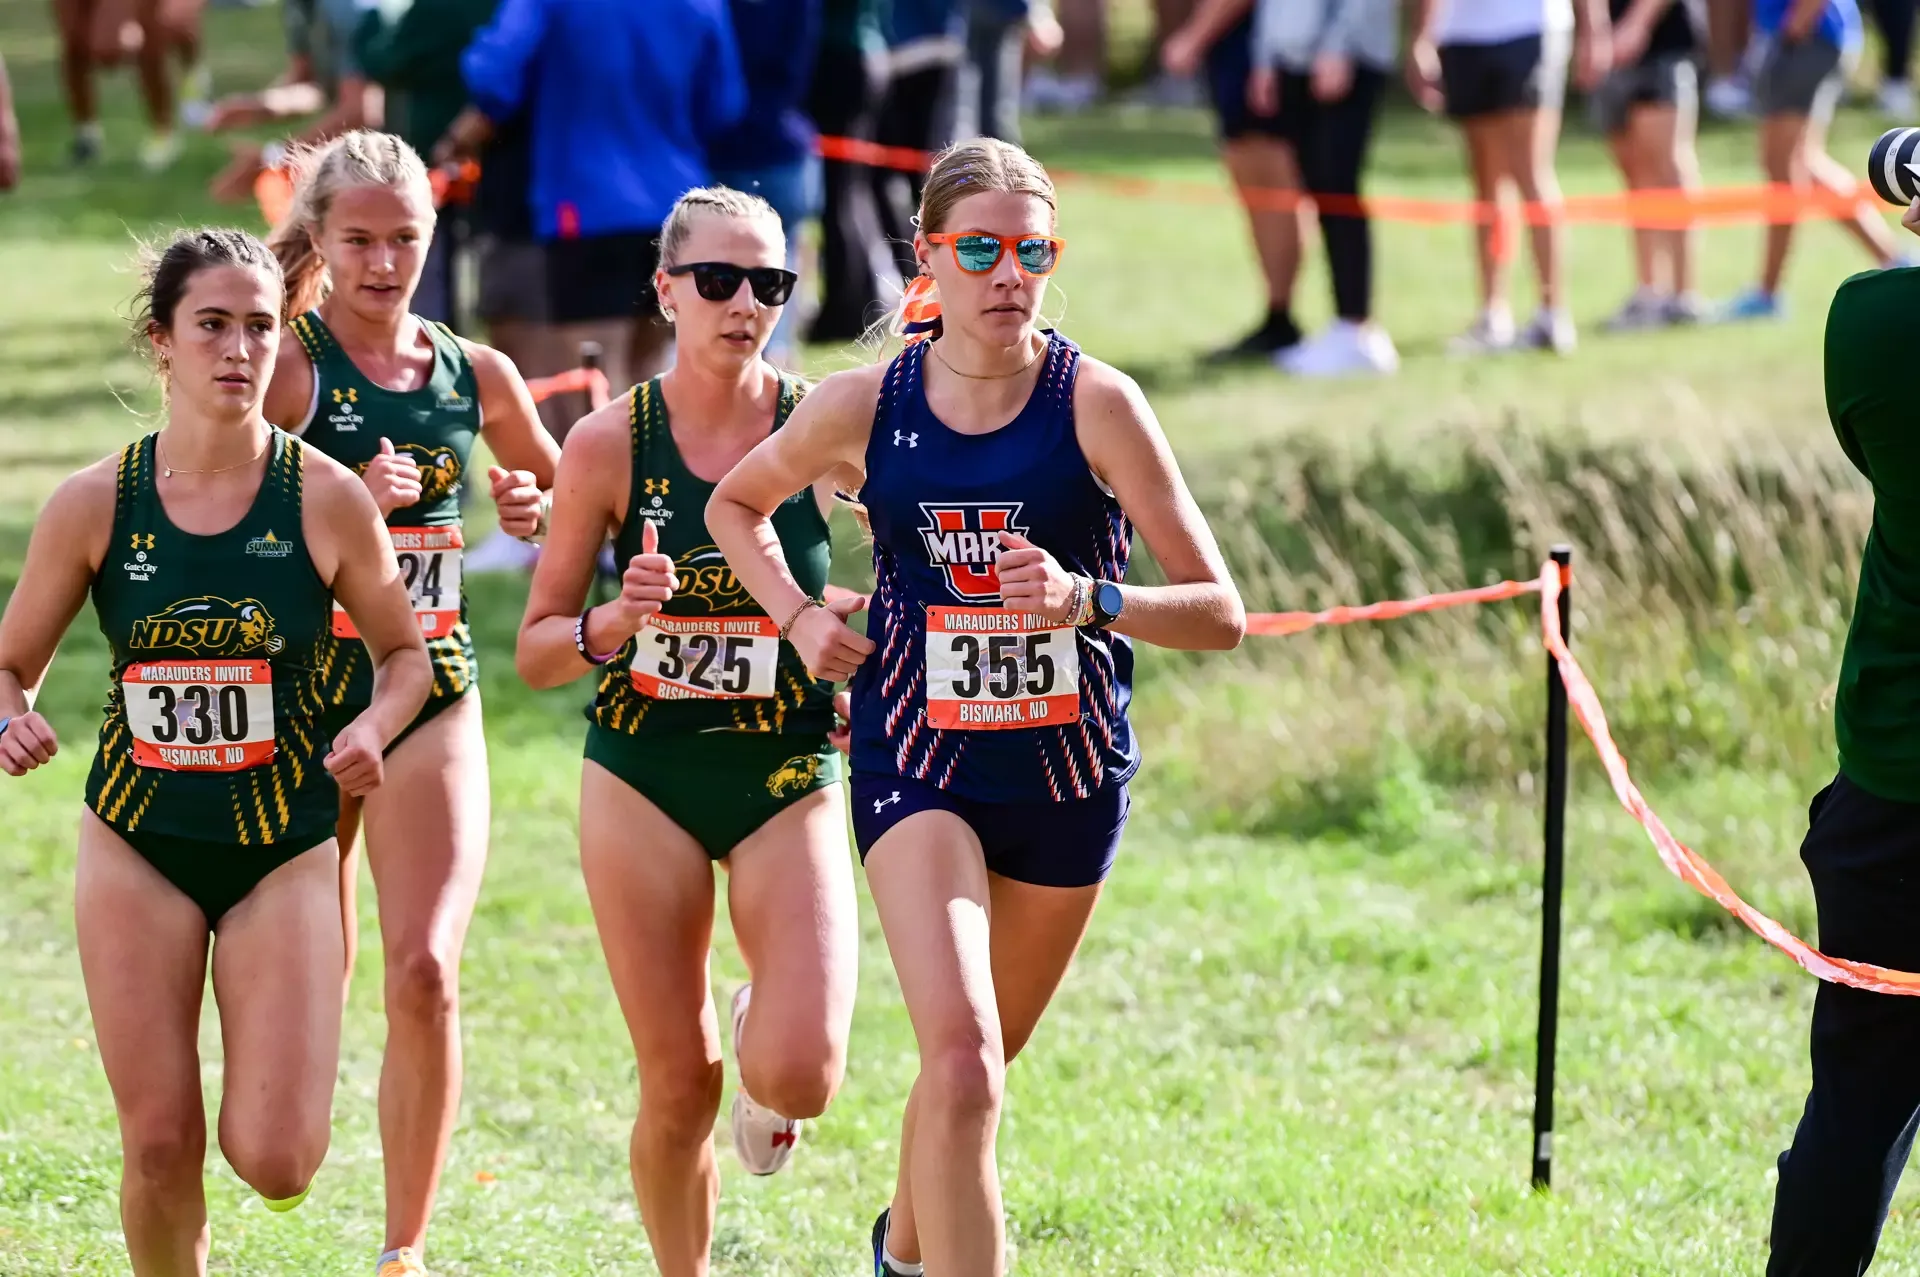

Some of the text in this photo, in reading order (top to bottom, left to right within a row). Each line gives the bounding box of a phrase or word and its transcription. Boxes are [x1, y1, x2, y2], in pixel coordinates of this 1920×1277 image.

[245, 540, 293, 554] SUMMIT
[926, 531, 1022, 564] MAR
[130, 572, 150, 581] Bank
[397, 552, 443, 608] 24
[674, 566, 742, 597] DSU
[130, 619, 237, 649] NDSU
[650, 616, 761, 633] MARAUDERS INVITE
[944, 613, 1019, 631] MARAUDERS
[141, 666, 253, 682] MARAUDERS INVITE
[654, 633, 754, 694] 325
[951, 632, 1055, 699] 355
[148, 685, 249, 745] 330
[960, 700, 1048, 722] BISMARK, ND
[159, 746, 245, 766] BISMARK, ND
